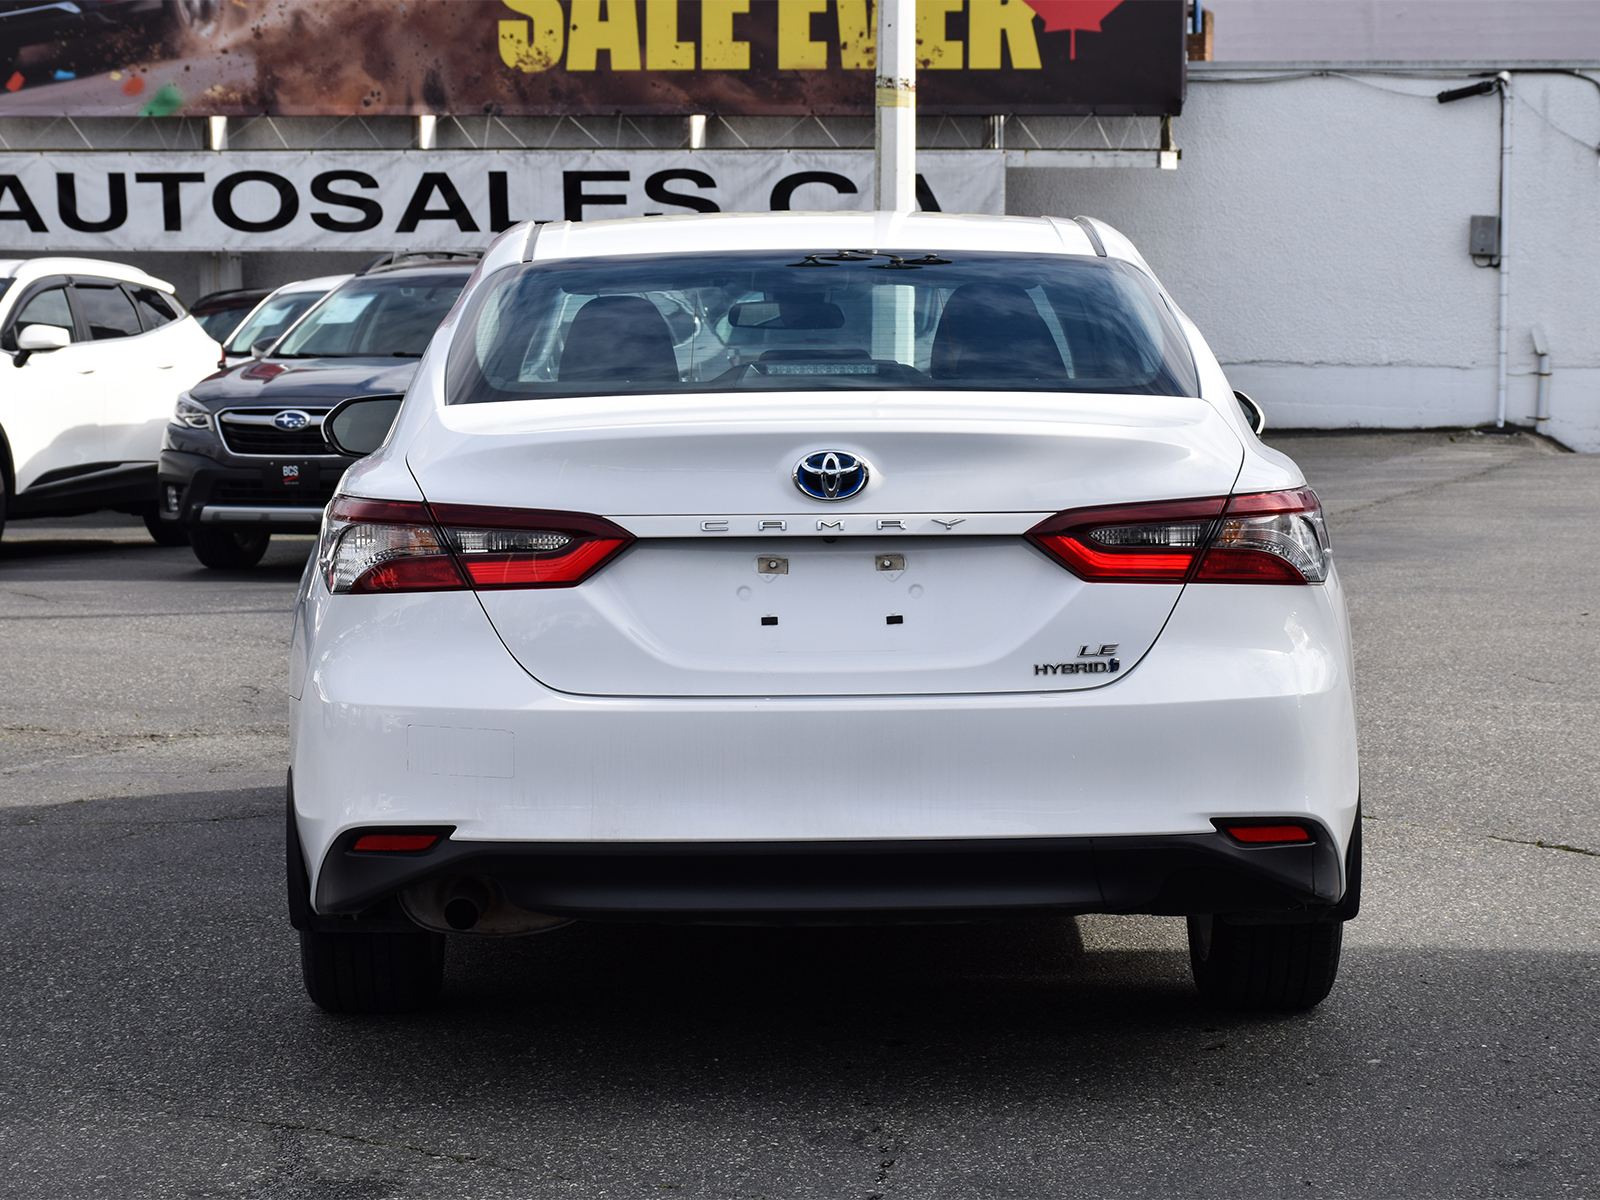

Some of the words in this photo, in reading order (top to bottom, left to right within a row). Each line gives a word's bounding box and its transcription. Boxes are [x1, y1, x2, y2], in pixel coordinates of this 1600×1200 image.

[498, 0, 750, 72] SALE
[778, 0, 1042, 70] EER
[282, 465, 299, 477] BCS
[700, 518, 966, 532] CAMRY
[1077, 643, 1119, 657] LE
